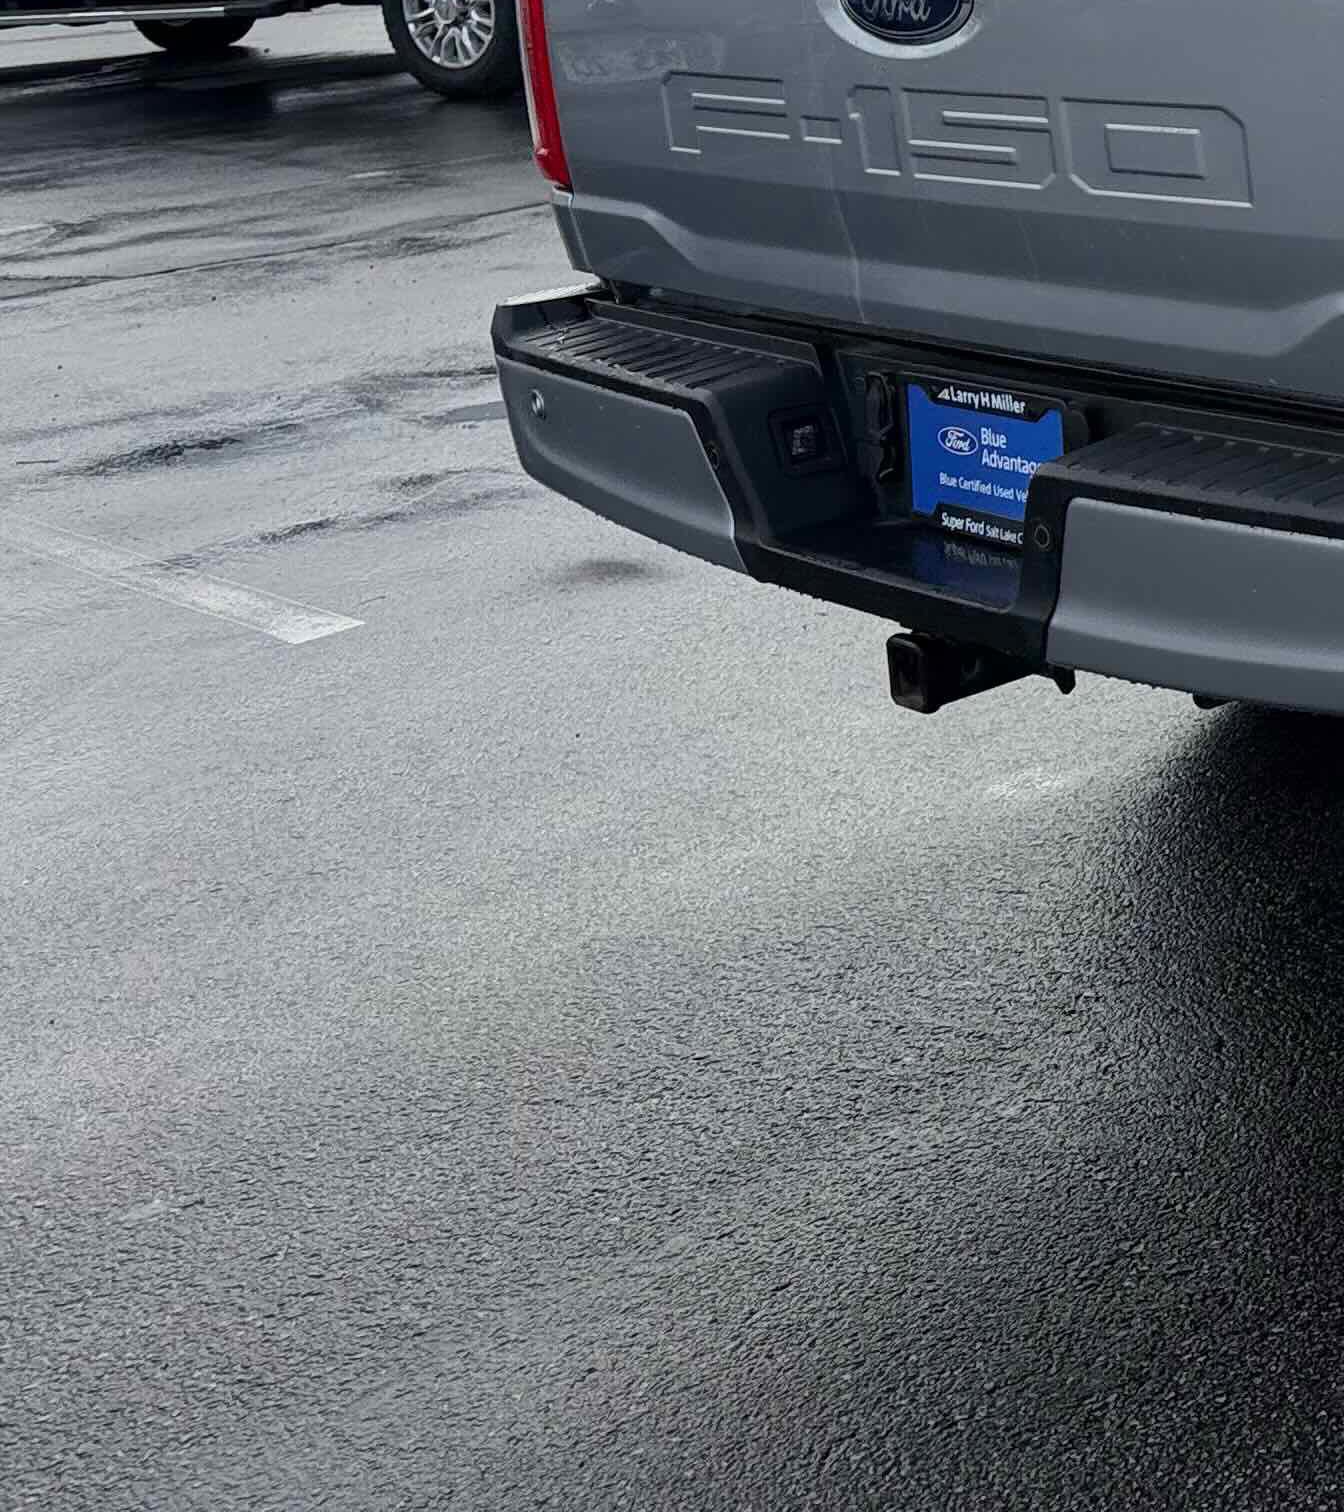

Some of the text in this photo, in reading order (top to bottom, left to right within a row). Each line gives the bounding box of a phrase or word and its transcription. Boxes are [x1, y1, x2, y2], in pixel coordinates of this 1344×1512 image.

[662, 70, 1254, 208] F-150
[949, 385, 1026, 414] Larry H Miller
[944, 430, 972, 452] Ford
[980, 427, 1007, 449] Blue
[981, 449, 1041, 479] Advantag
[939, 472, 958, 487] Blue
[958, 476, 992, 496] Certified
[993, 483, 1015, 500] Used
[941, 511, 965, 531] Super
[965, 517, 985, 536] Ford
[985, 525, 999, 540] Salt
[999, 527, 1017, 543] Lake
